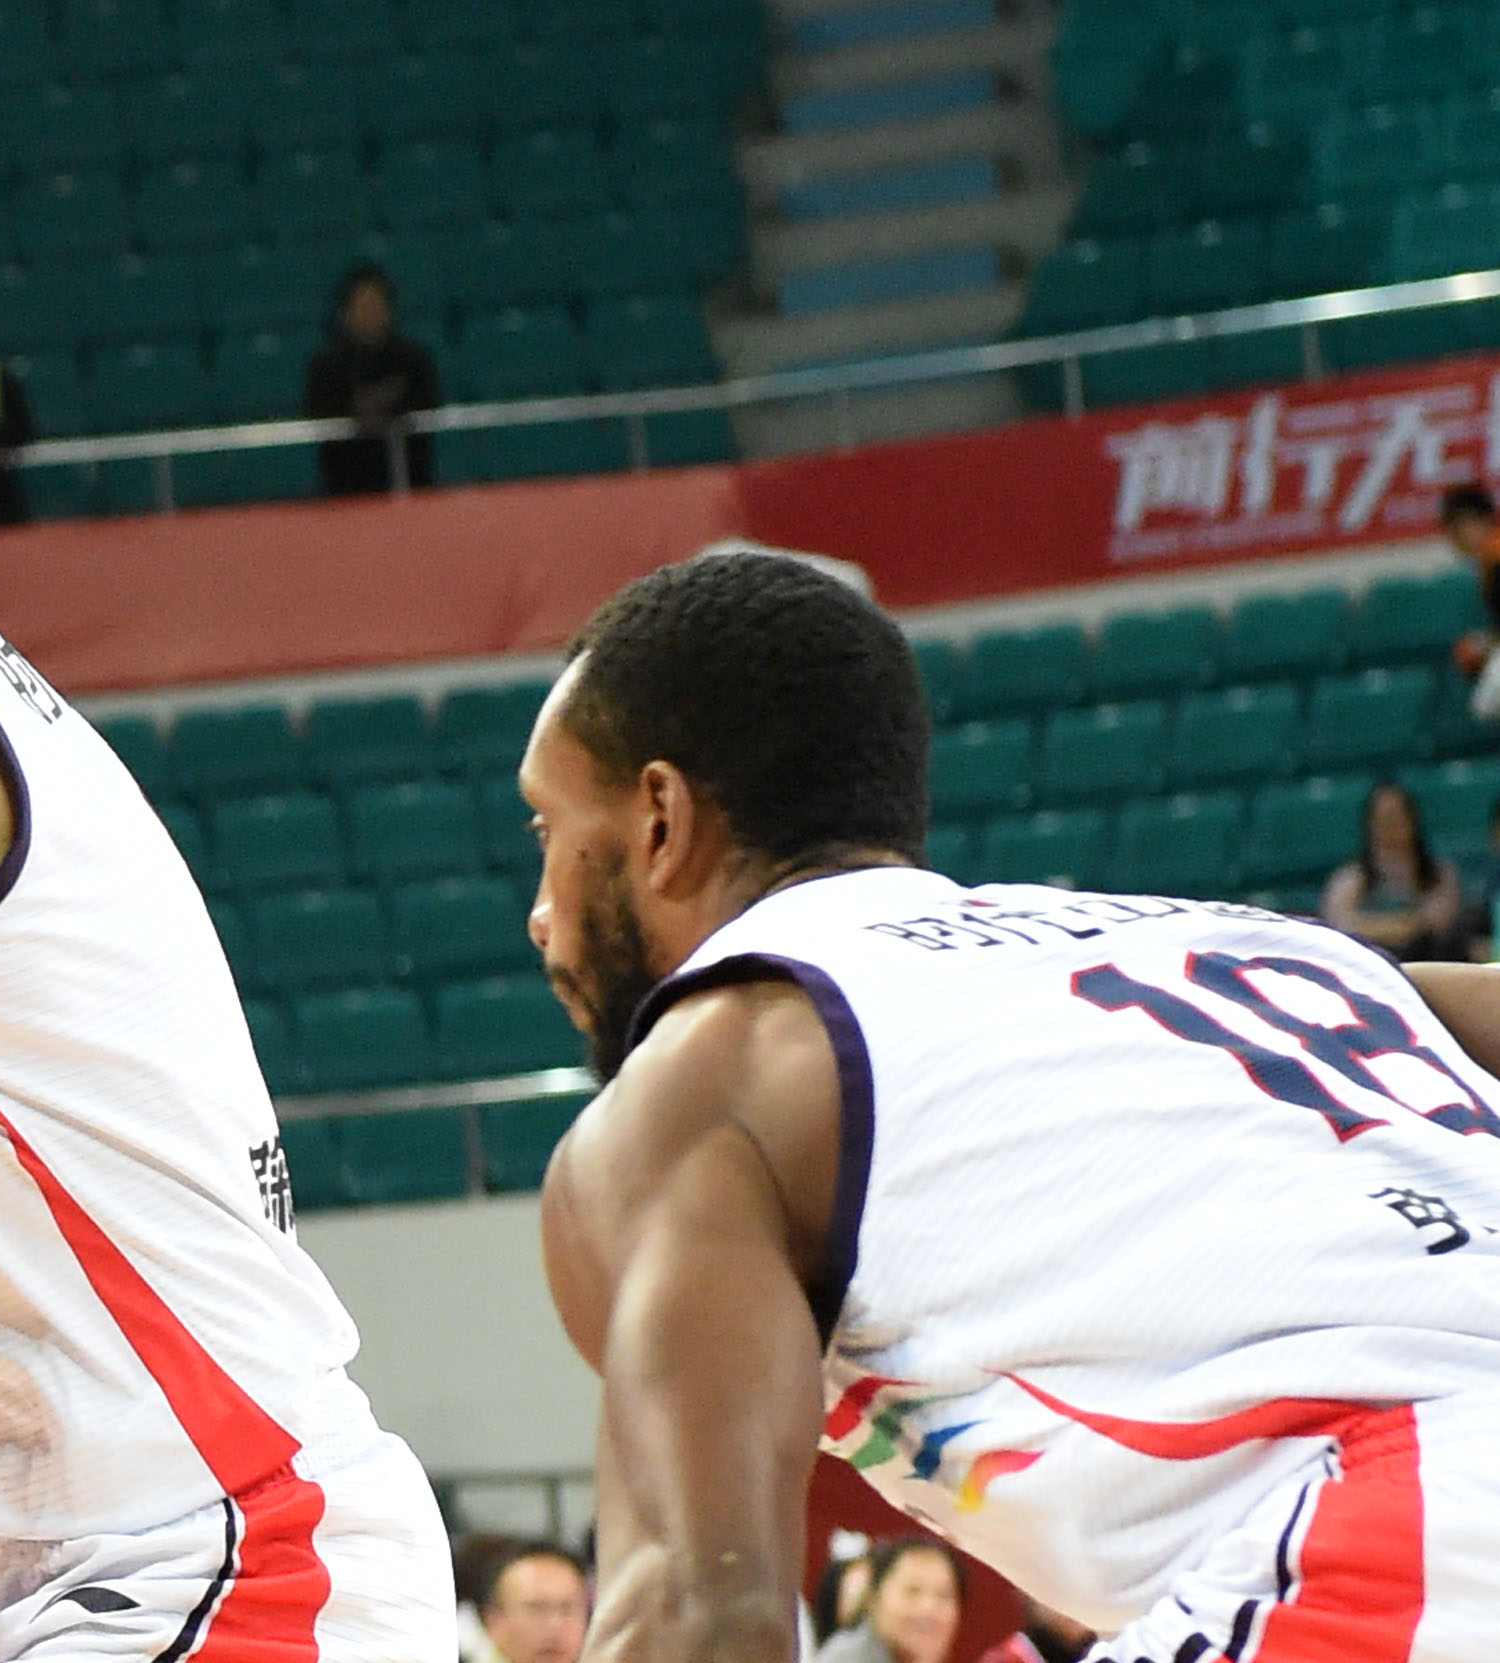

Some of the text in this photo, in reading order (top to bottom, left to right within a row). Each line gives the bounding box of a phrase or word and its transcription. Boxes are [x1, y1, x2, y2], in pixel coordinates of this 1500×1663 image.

[1106, 374, 1500, 560] 前行无
[1070, 950, 1500, 1143] 18
